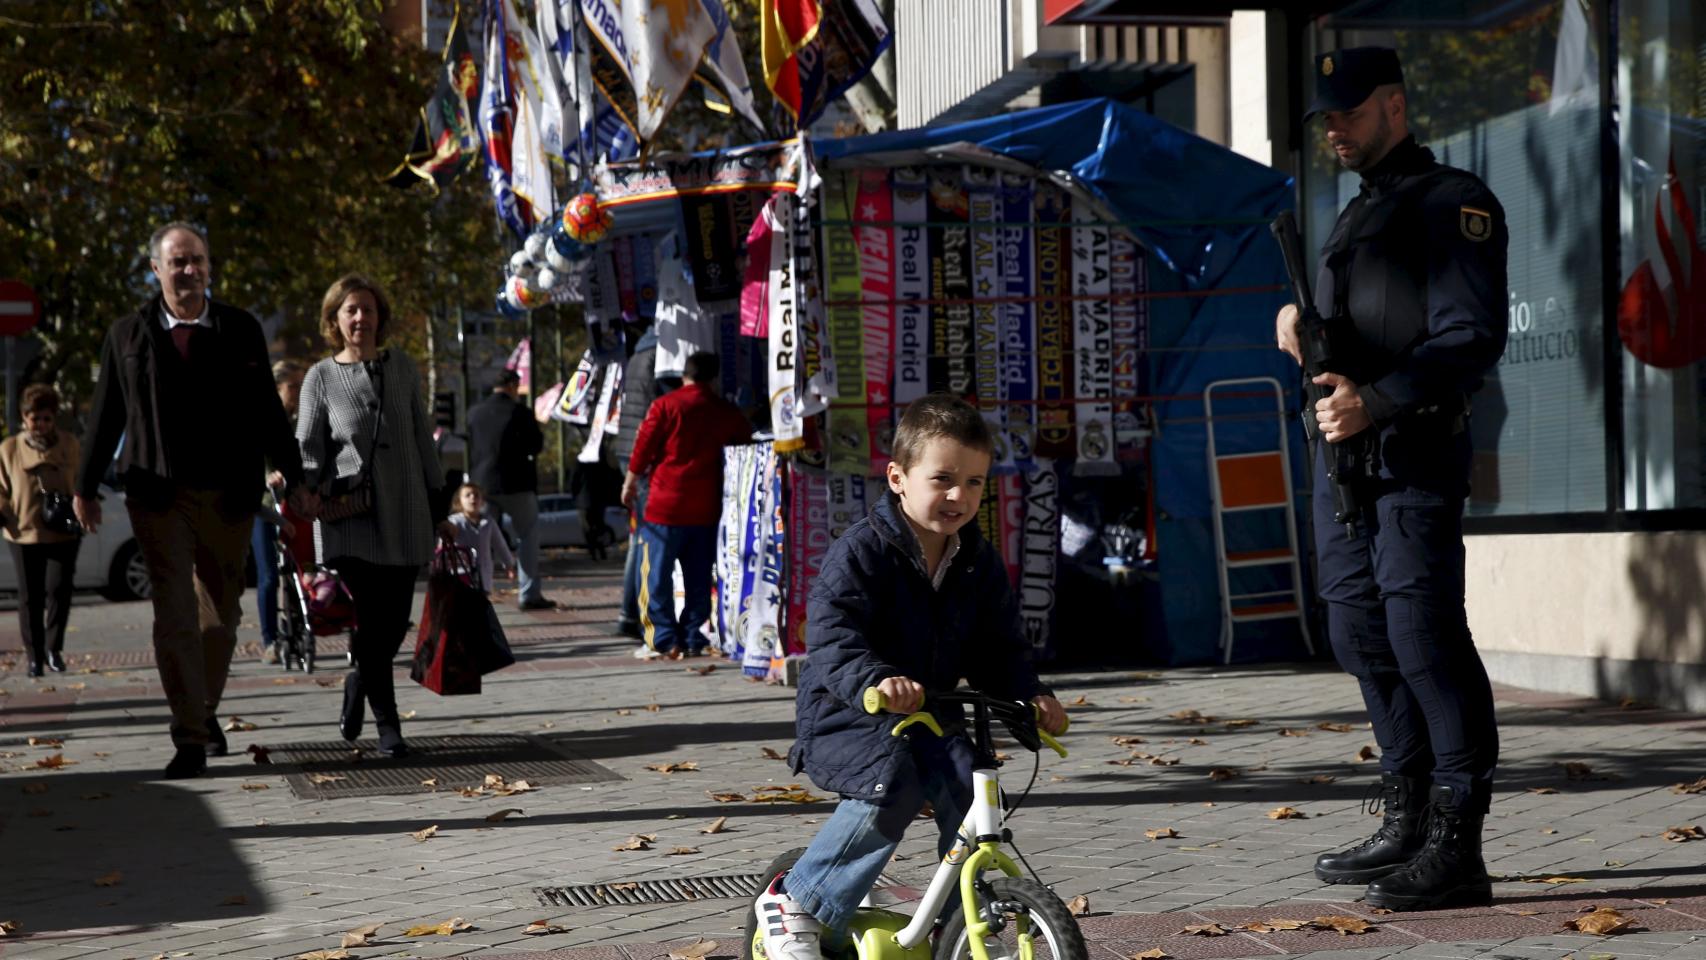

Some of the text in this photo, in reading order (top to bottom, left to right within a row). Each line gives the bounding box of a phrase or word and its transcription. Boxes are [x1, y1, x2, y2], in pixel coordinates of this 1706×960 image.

[861, 226, 889, 385] REAL MADRID
[902, 225, 920, 383] Real Madrid
[1005, 225, 1027, 384] Real Madrid
[1091, 212, 1109, 284] ALA
[832, 292, 862, 398] MADRID
[1021, 470, 1055, 612] ULTRAS
